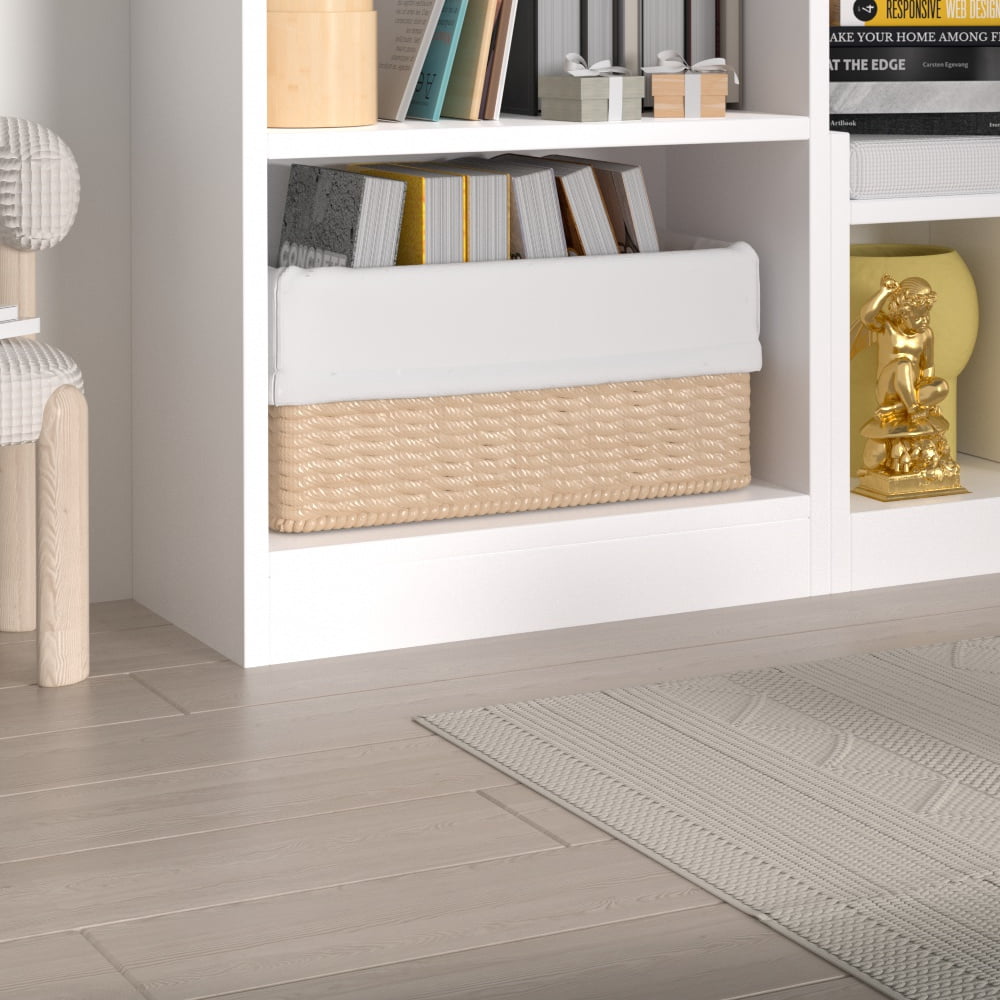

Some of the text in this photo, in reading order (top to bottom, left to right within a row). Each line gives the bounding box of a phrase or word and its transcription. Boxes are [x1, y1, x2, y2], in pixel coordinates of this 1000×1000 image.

[862, 4, 875, 14] 4
[886, 0, 942, 19] RESPONSIVE
[945, 0, 967, 19] WEB
[857, 31, 894, 43] YOUR
[896, 31, 936, 43] HOME
[939, 31, 988, 43] AMONG
[843, 58, 869, 71] THE
[871, 58, 906, 71] EDGE
